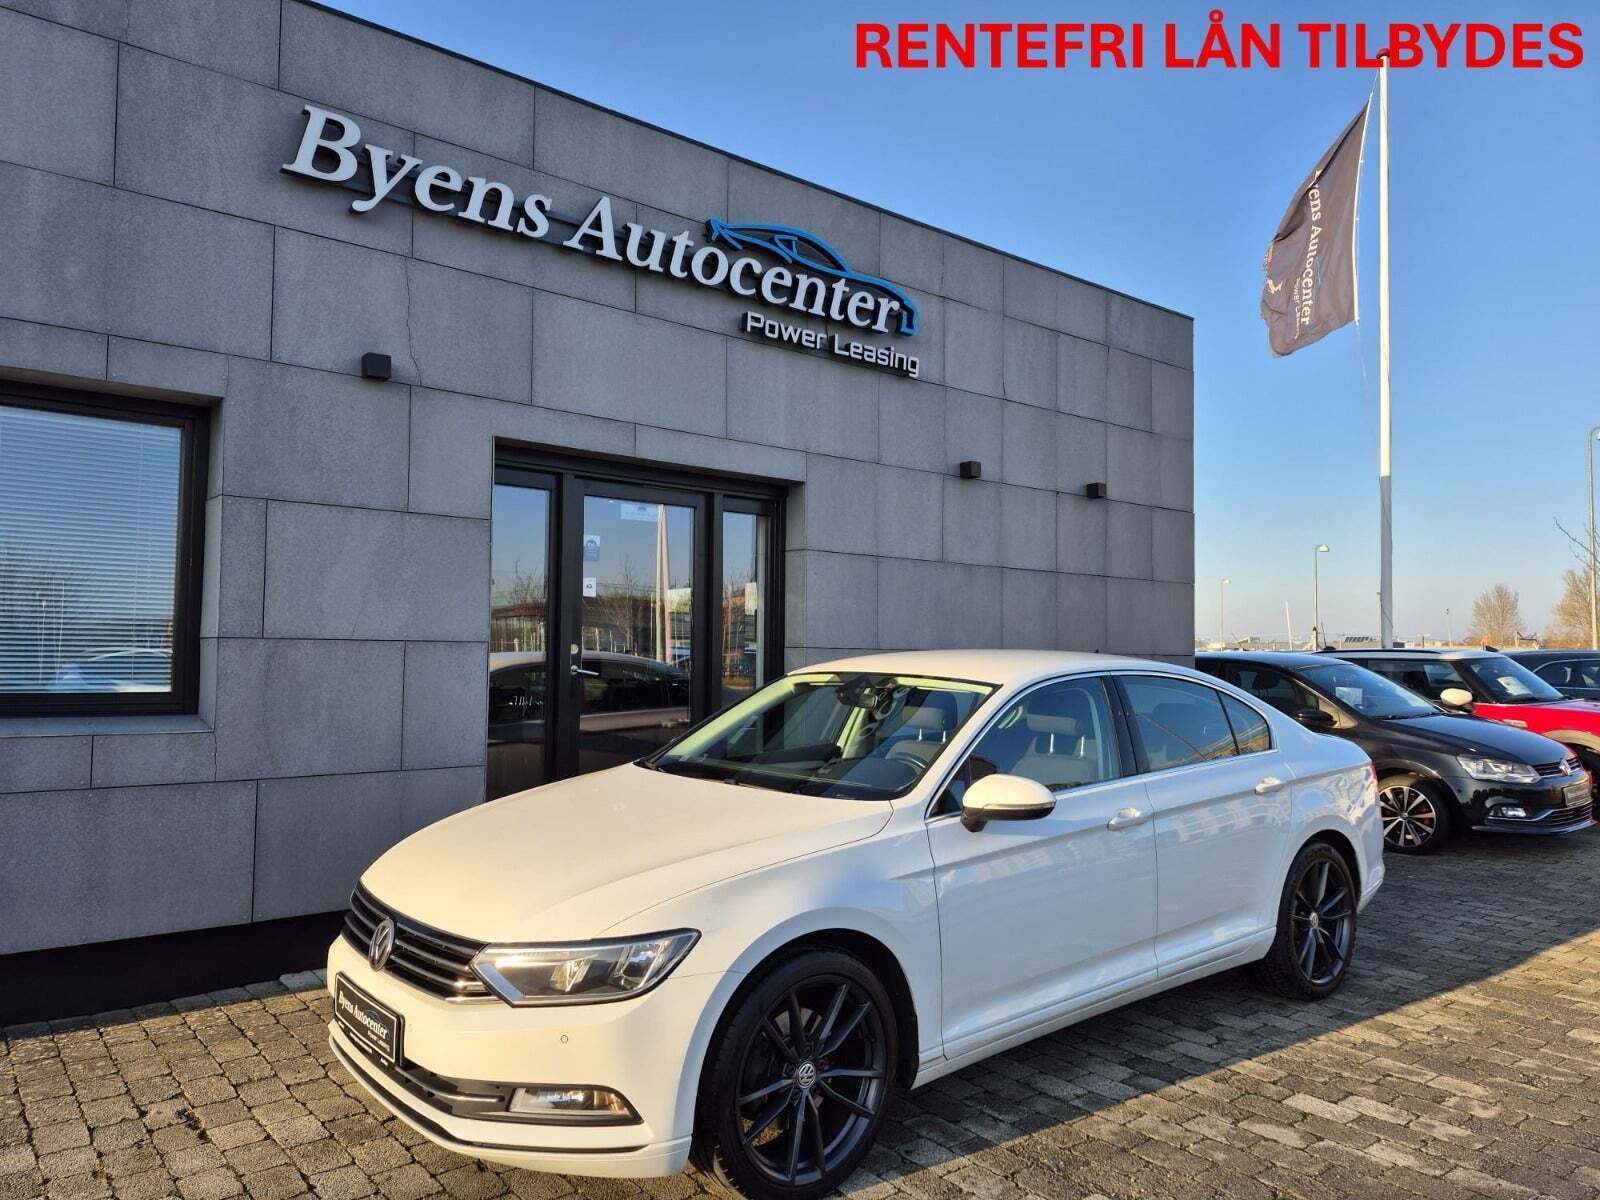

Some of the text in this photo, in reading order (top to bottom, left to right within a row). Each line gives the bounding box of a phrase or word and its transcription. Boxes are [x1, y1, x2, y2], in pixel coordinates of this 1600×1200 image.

[282, 104, 899, 335] Byens Autocenter
[745, 311, 920, 378] Power Leasing
[353, 1005, 389, 1040] Autocenter
